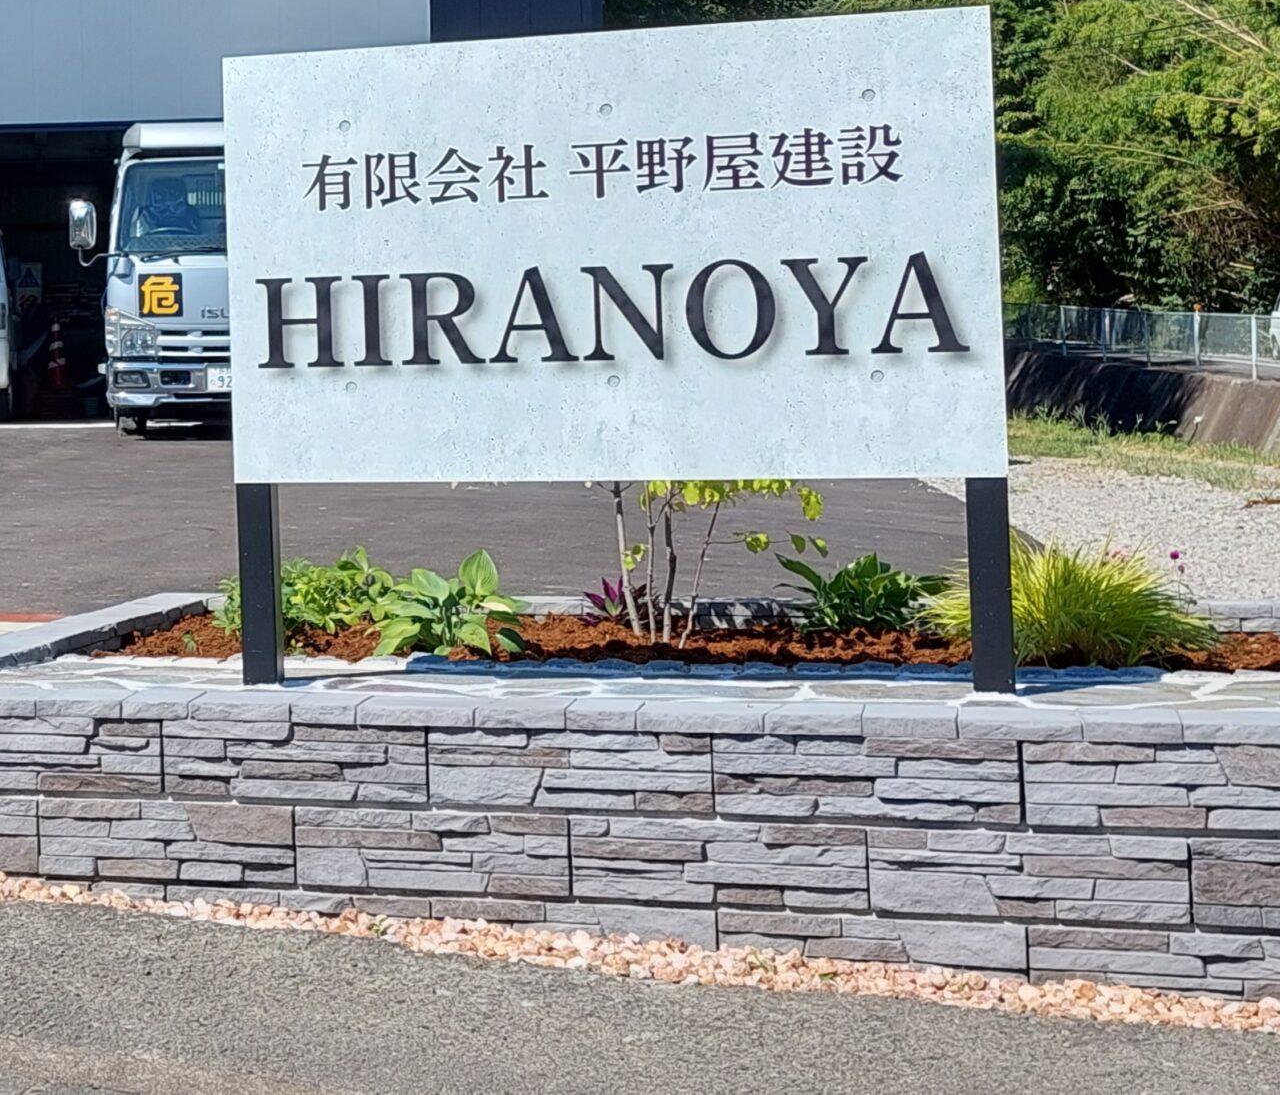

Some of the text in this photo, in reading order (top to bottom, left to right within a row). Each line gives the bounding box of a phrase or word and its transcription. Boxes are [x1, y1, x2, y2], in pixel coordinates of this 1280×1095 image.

[302, 124, 903, 211] 有限会社 平野屋建設
[141, 275, 180, 314] 危
[256, 251, 970, 369] HIRANOYA
